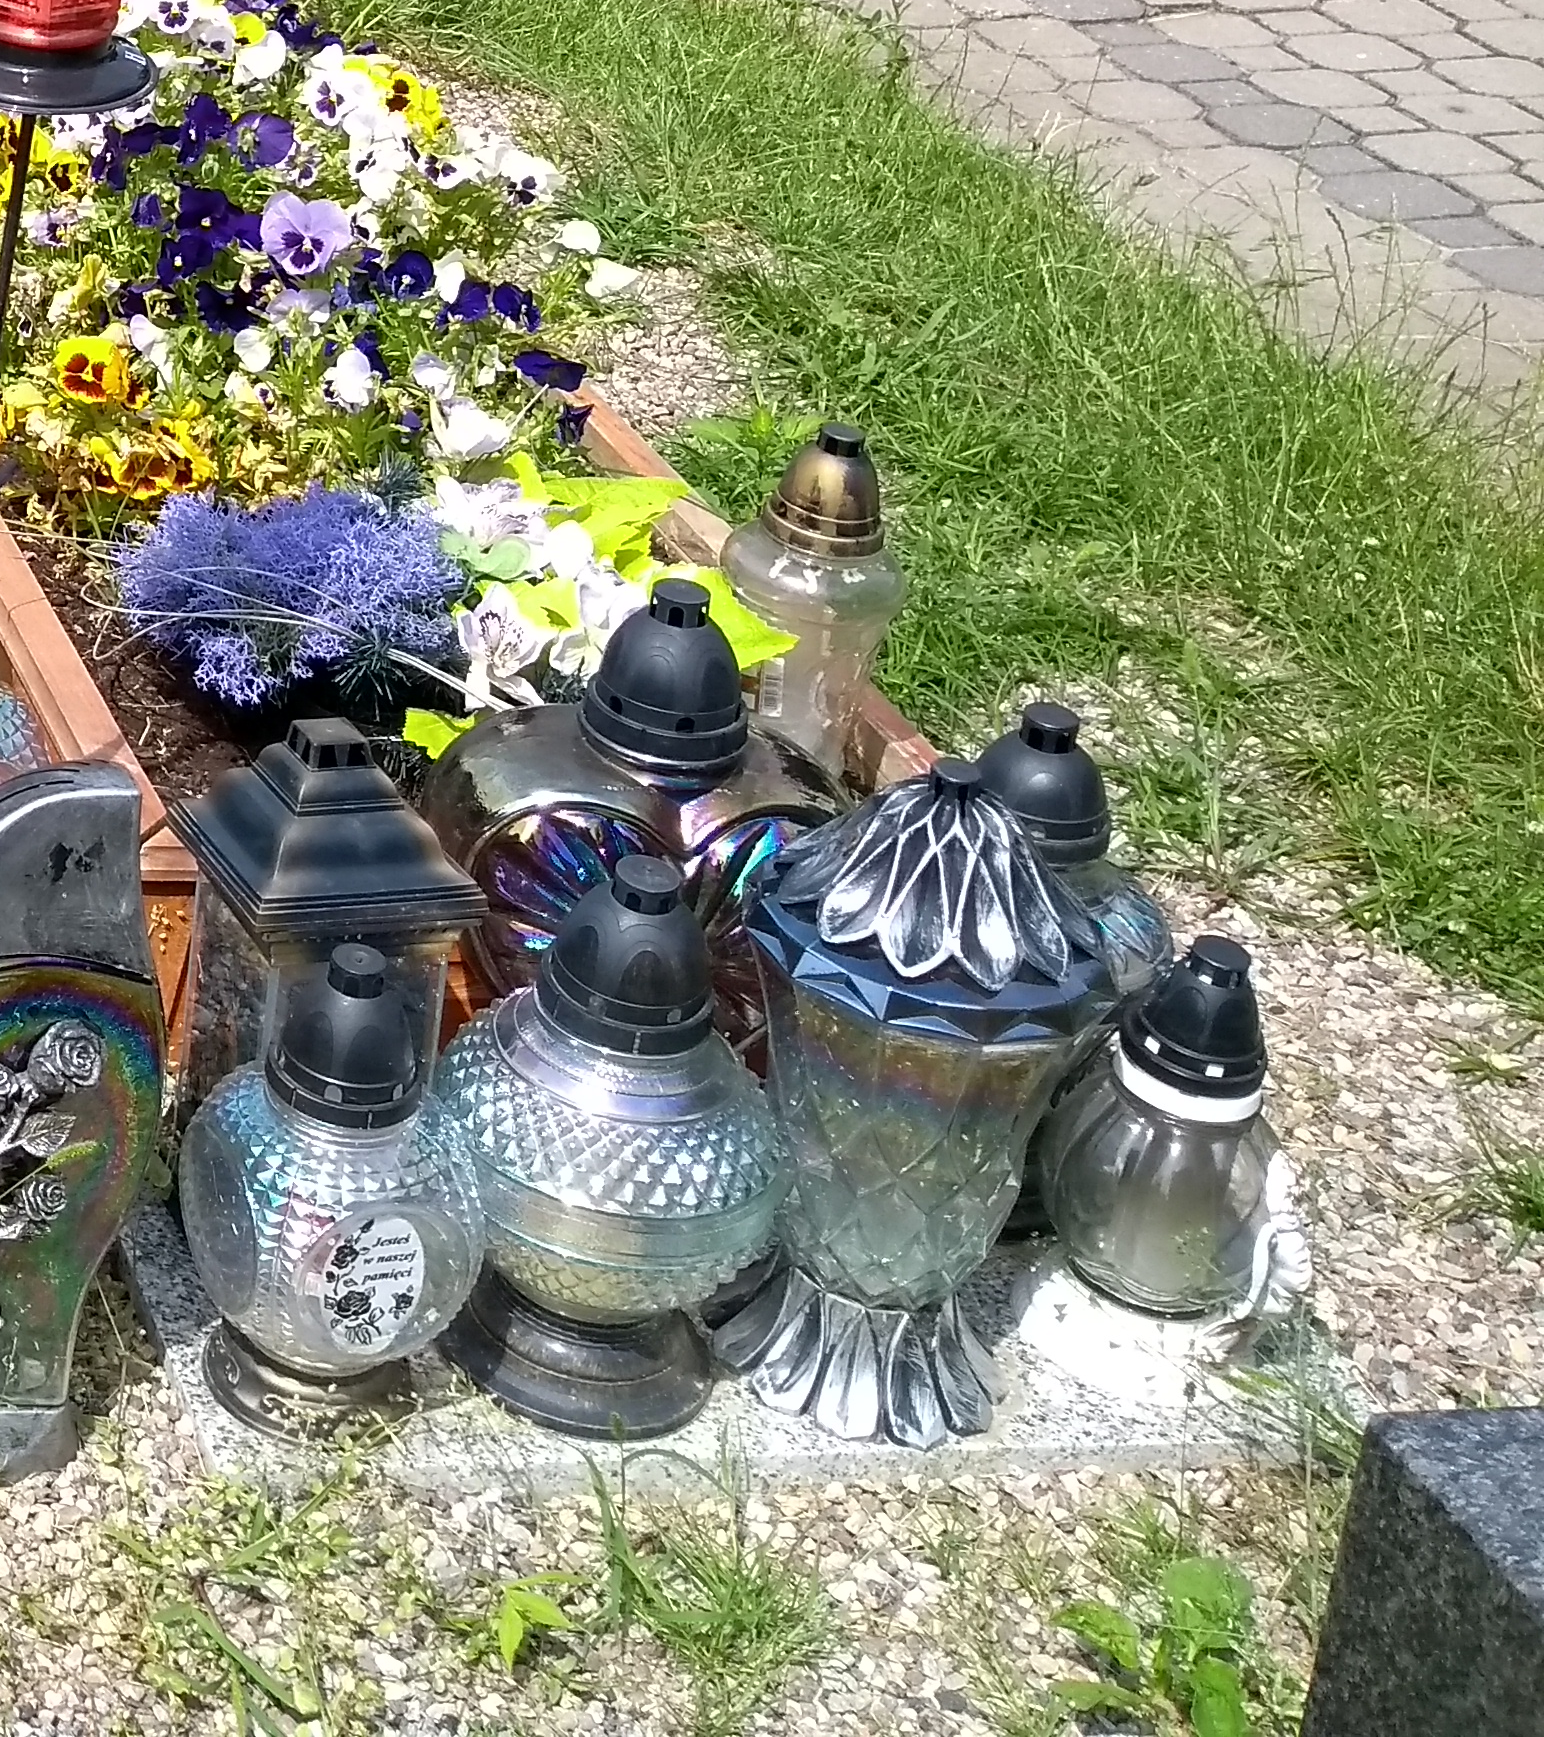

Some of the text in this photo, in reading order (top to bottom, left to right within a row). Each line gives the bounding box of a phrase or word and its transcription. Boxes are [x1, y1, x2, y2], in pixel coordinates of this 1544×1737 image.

[372, 1232, 412, 1248] Jesteś
[363, 1249, 418, 1266] w naszej
[360, 1266, 414, 1286] pamięci
